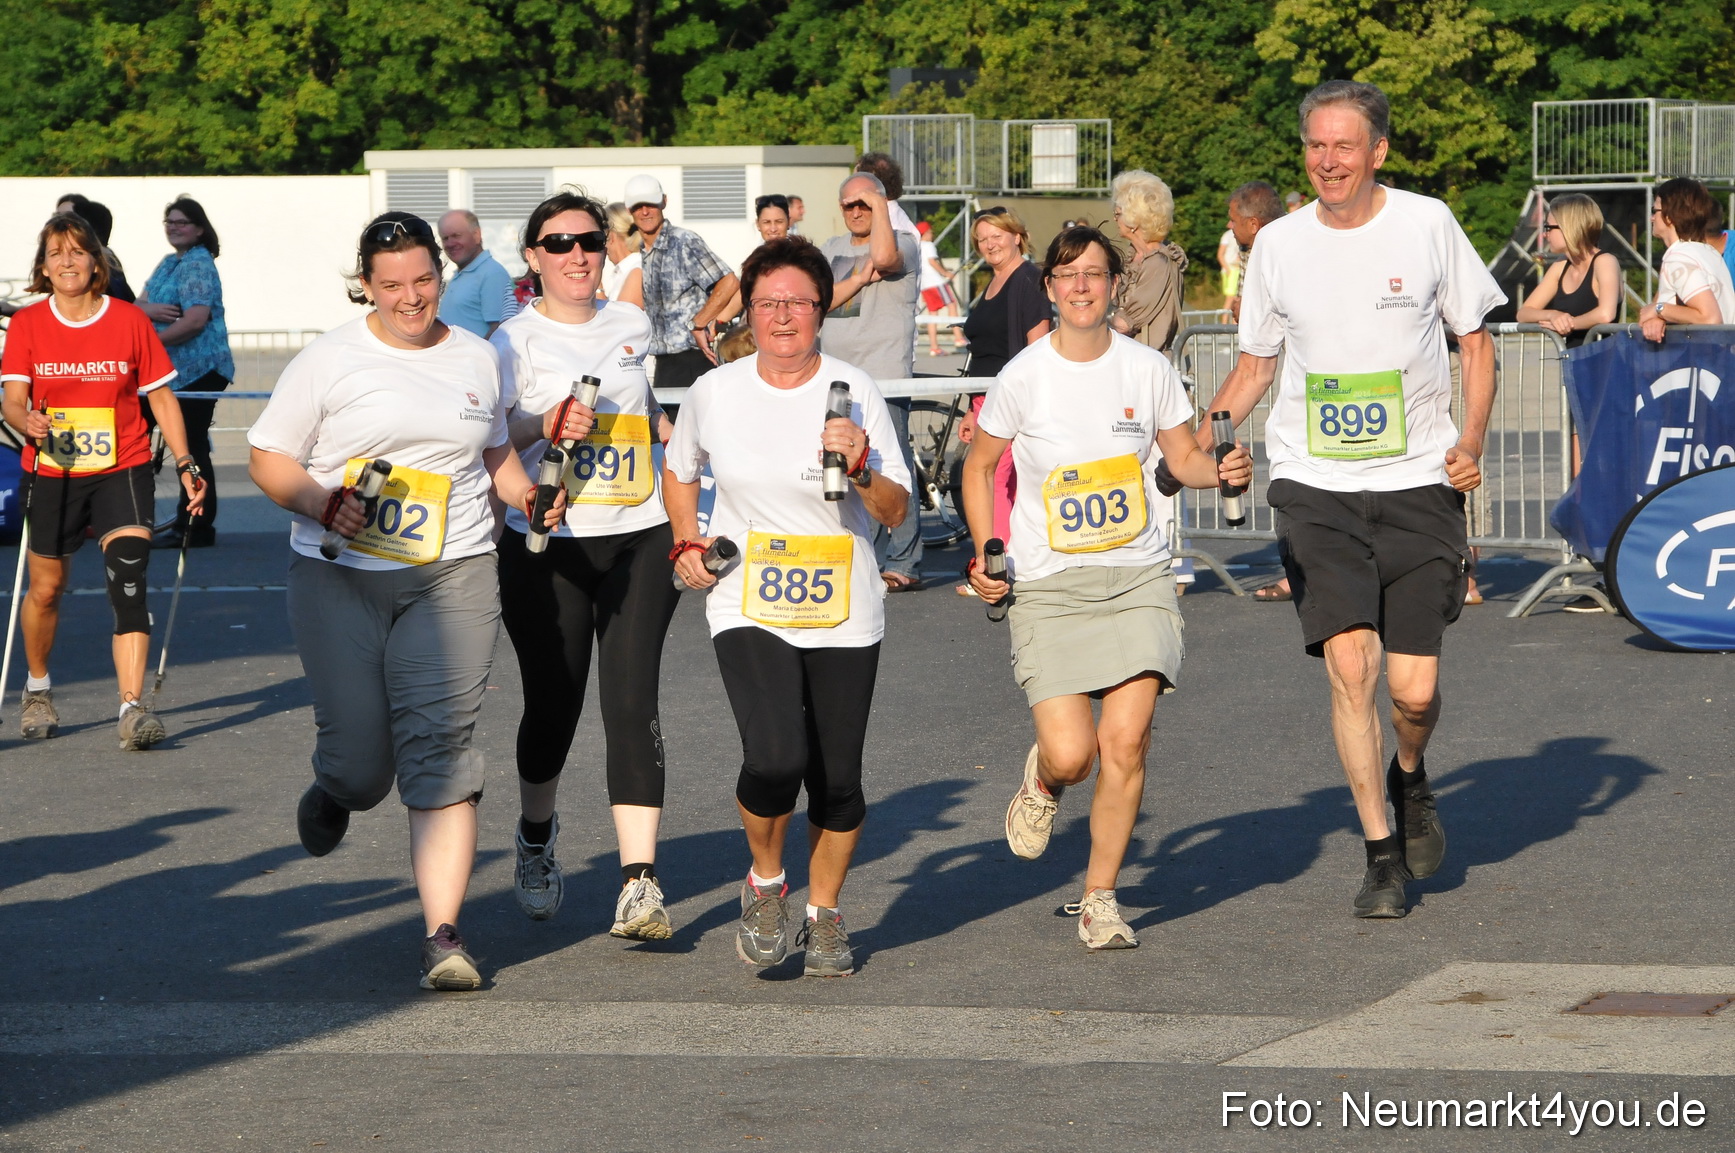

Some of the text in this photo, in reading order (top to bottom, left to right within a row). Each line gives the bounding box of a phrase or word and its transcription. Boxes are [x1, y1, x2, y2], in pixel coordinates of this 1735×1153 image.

[1375, 300, 1419, 310] Lammsbräu
[34, 360, 116, 375] NEUMARKT
[1320, 402, 1388, 437] 899
[47, 429, 112, 457] 1335
[1351, 444, 1379, 452] Lammsbräu
[573, 445, 635, 482] 891
[1059, 488, 1130, 532] 903
[365, 532, 387, 543] Kathrin
[1080, 527, 1119, 539] Stefanie Zeuch
[1066, 539, 1096, 548] Neumarkter
[1096, 534, 1124, 544] Lammsbräu
[352, 539, 420, 558] eumarkter Lammsbräu KG
[762, 548, 801, 558] firmenlauf
[751, 558, 781, 567] walken
[758, 566, 834, 604] 885
